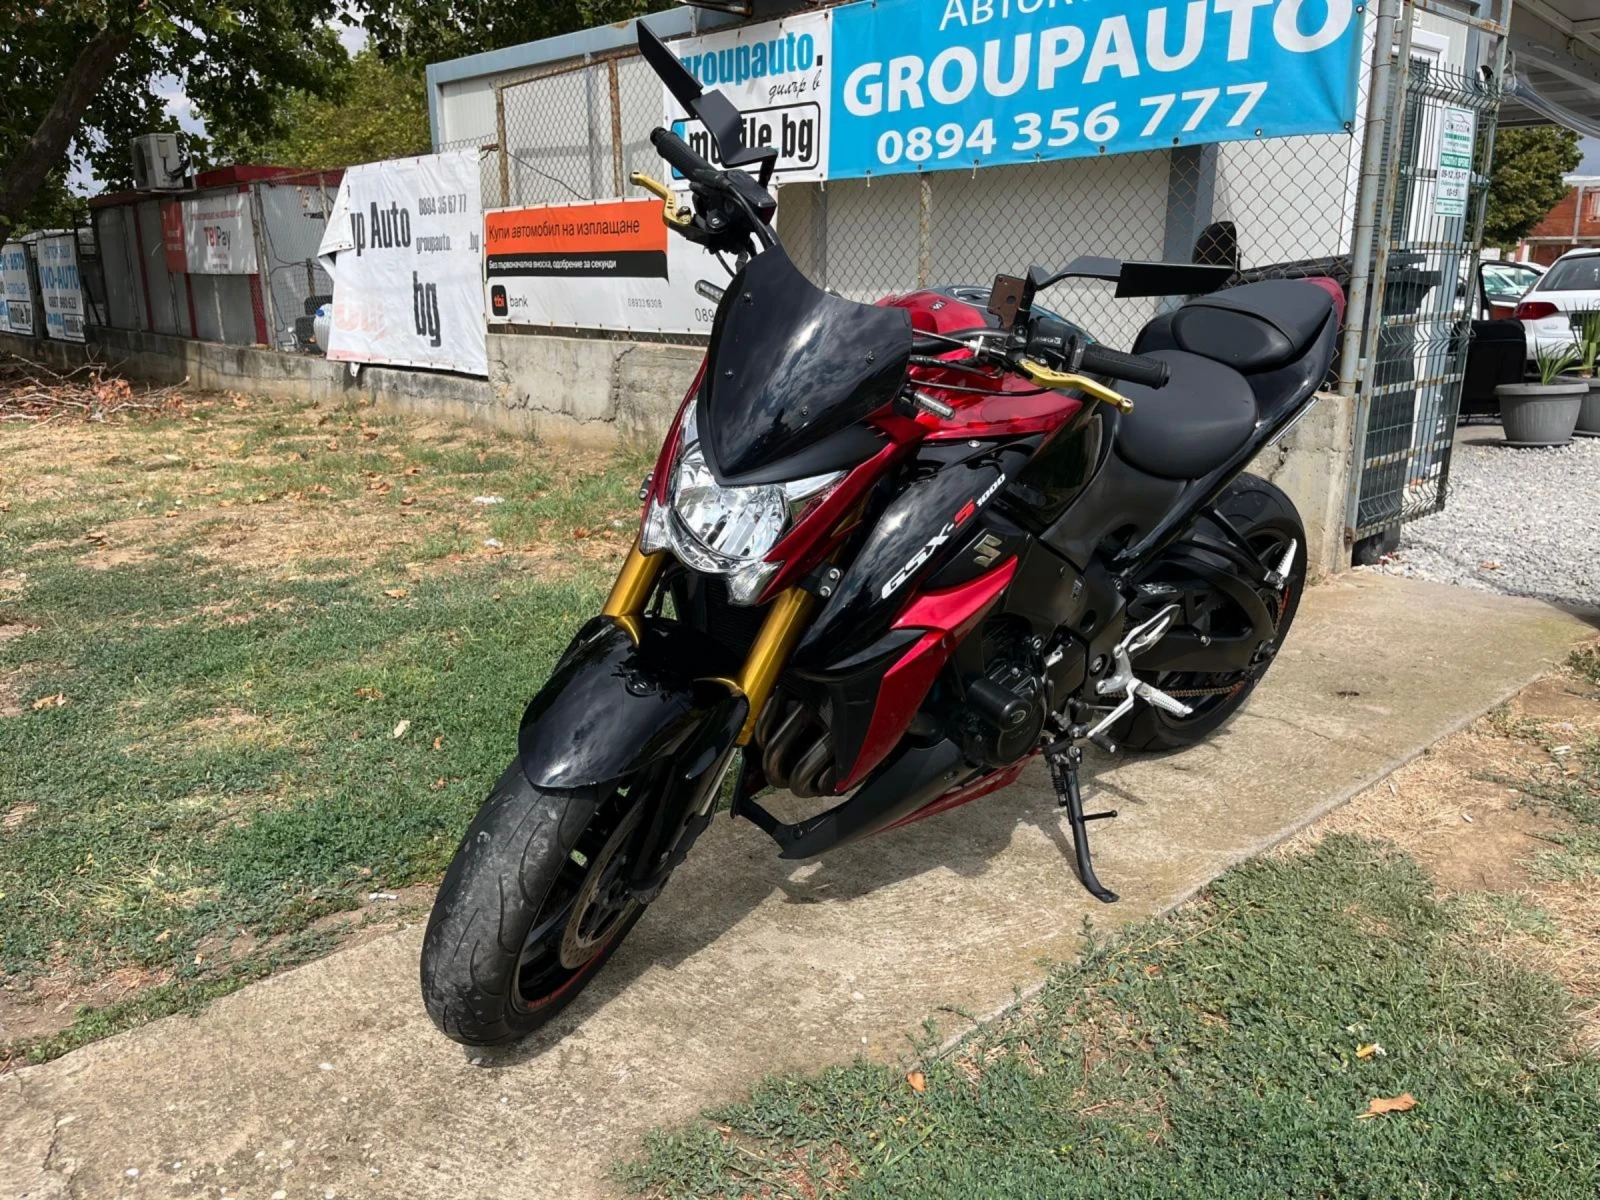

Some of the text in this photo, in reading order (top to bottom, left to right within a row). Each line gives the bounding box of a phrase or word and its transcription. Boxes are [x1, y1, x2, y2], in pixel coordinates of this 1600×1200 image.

[843, 0, 1350, 117] GROUPAUTO
[877, 81, 1268, 165] 0894 356 777
[438, 195, 447, 215] 35
[458, 193, 466, 213] 77
[371, 201, 411, 249] Auto
[488, 218, 640, 243] Купи автомобил на изплащане
[553, 259, 583, 270] одобрение
[583, 260, 590, 269] за
[591, 259, 617, 270] секунди
[412, 270, 442, 347] bg
[494, 294, 528, 308] tbi bank
